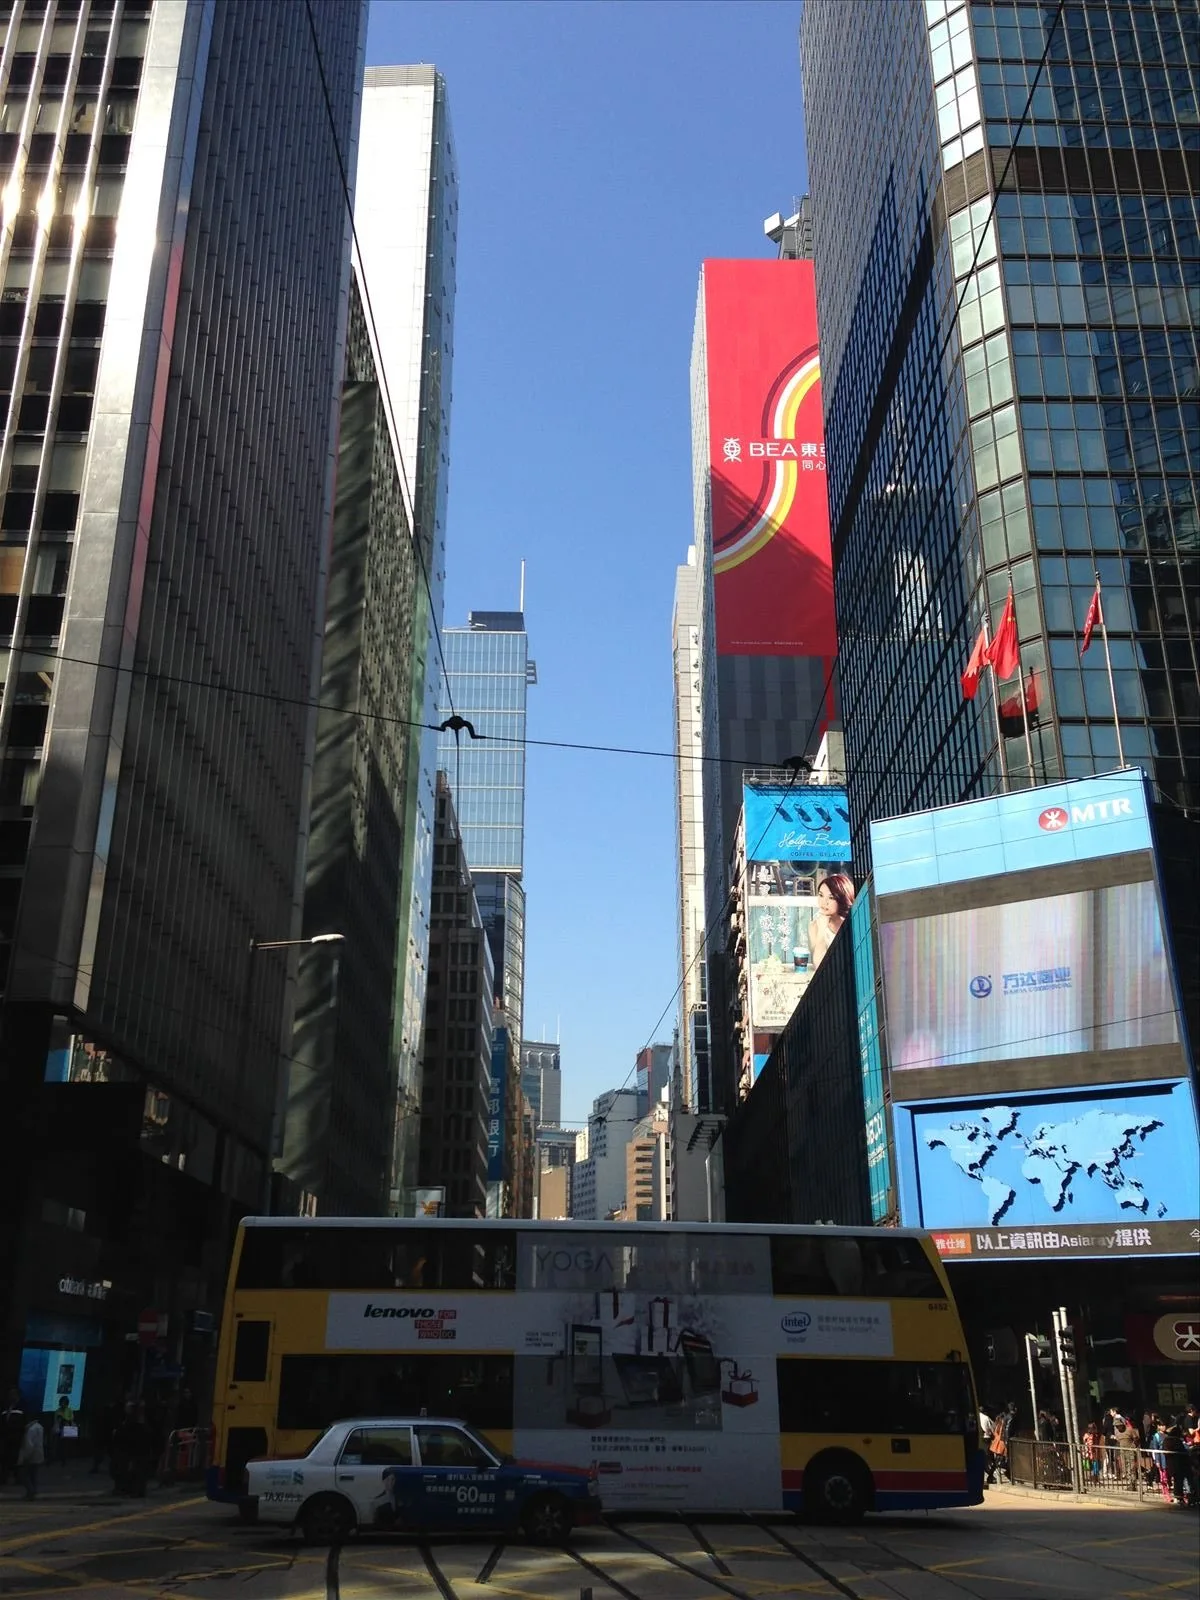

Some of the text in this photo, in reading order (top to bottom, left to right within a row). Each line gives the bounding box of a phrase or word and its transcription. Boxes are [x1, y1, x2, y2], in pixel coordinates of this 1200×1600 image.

[749, 442, 798, 457] BEA
[1071, 798, 1132, 824] MTR
[537, 1250, 614, 1273] YOGA
[364, 1304, 434, 1318] lenovo
[784, 1316, 806, 1328] intel
